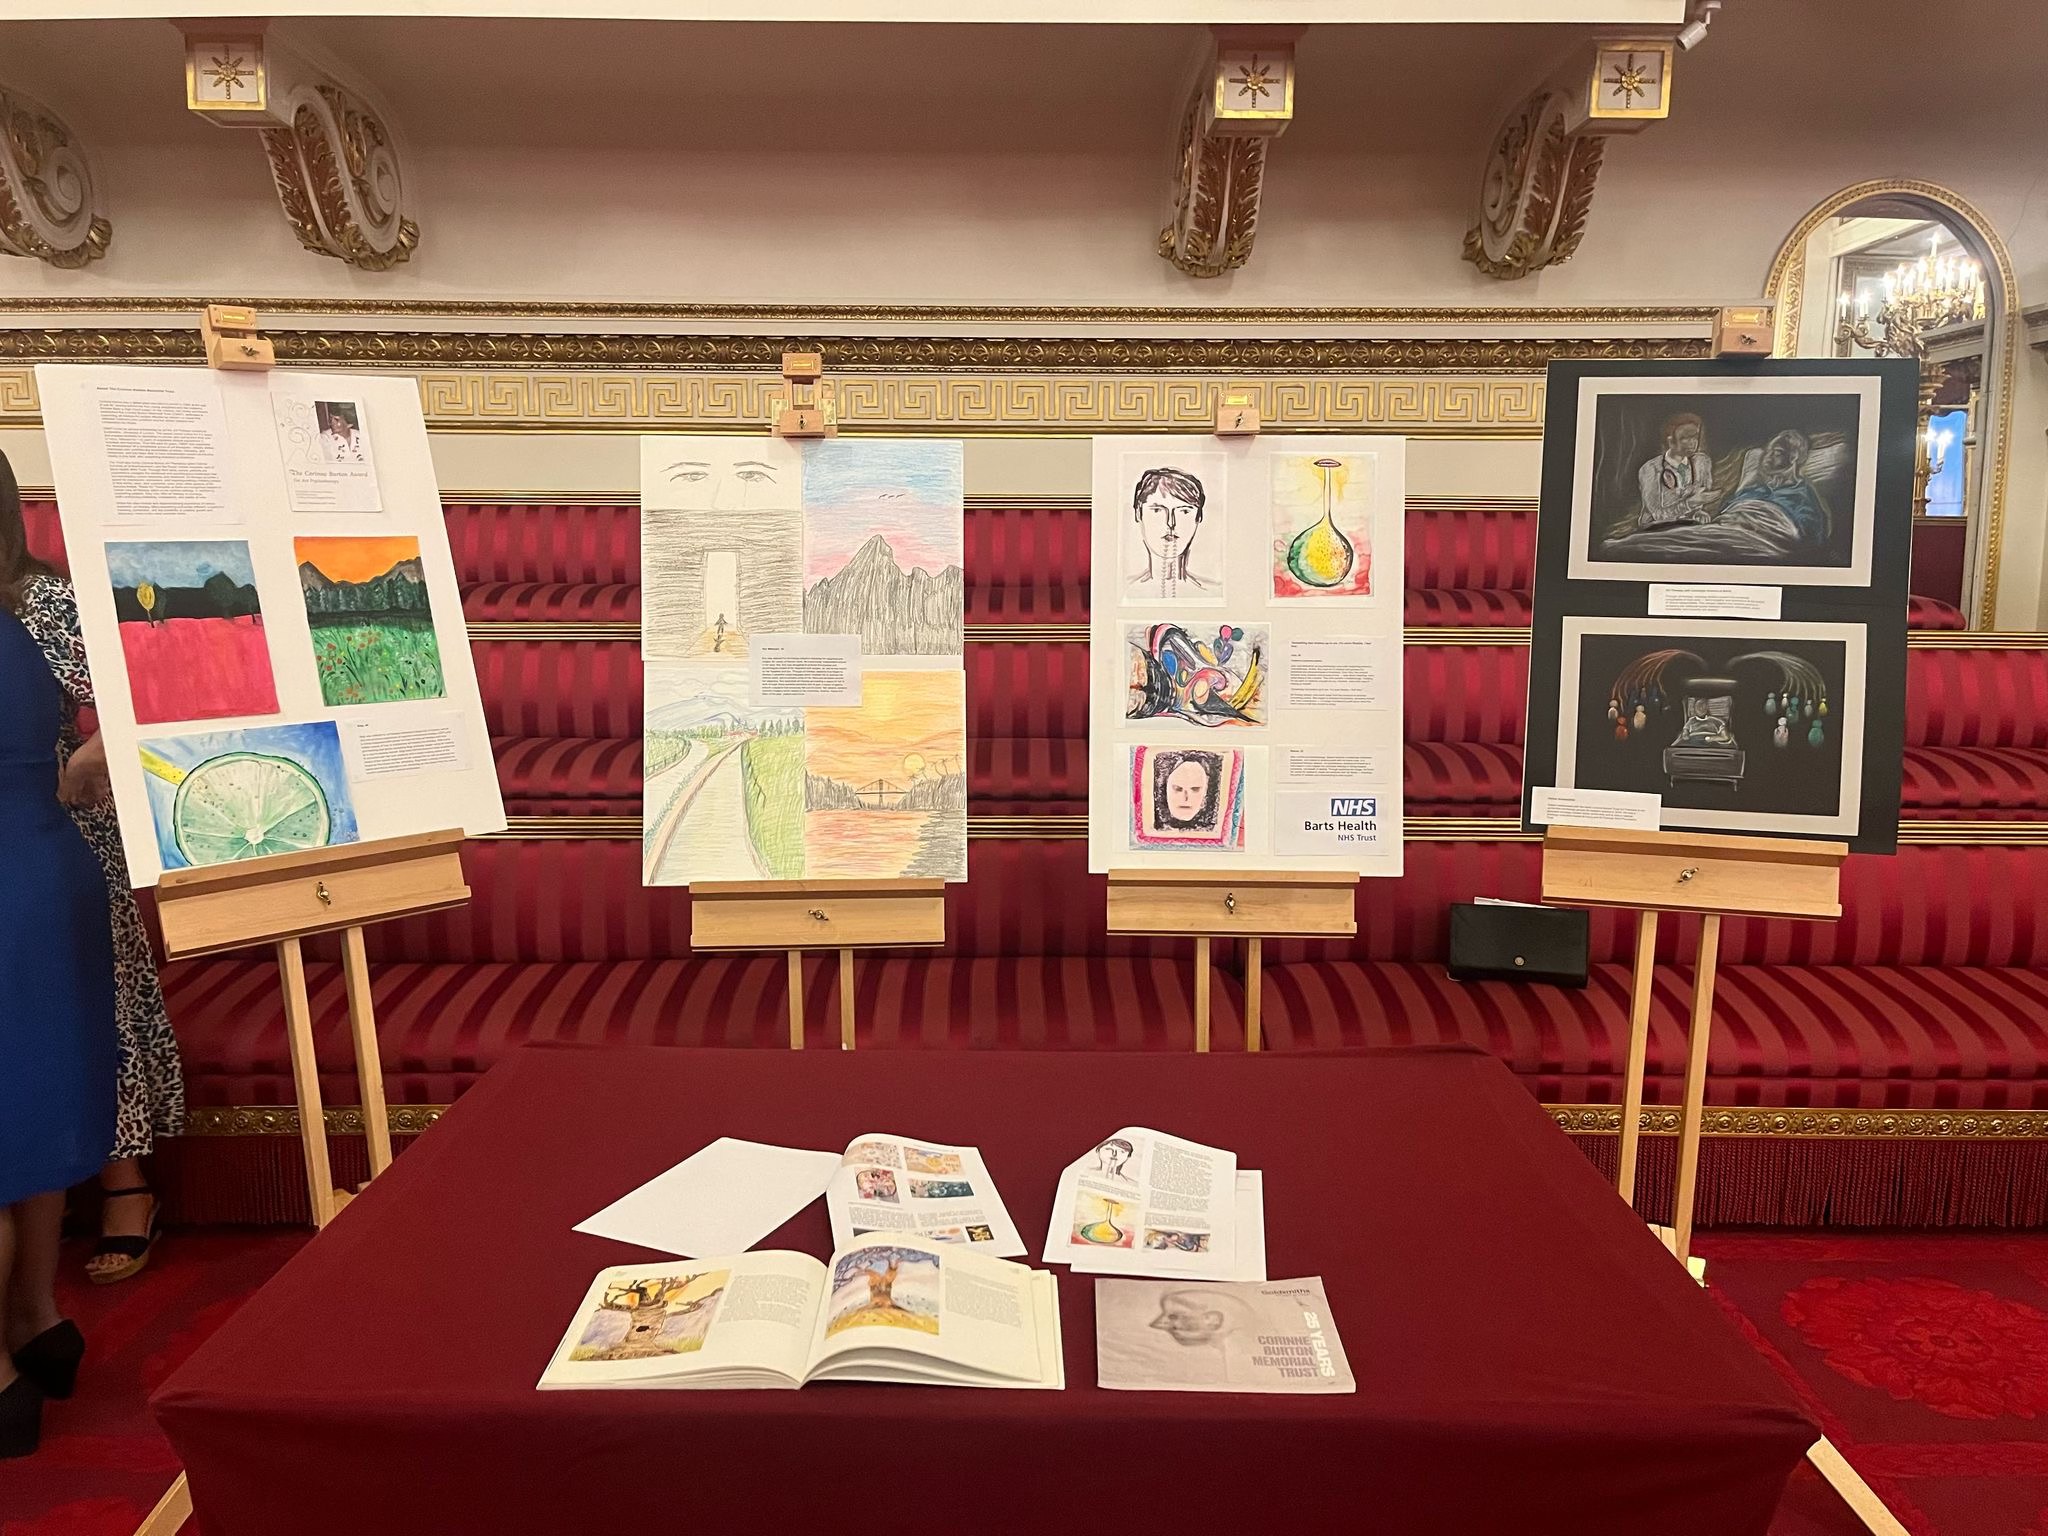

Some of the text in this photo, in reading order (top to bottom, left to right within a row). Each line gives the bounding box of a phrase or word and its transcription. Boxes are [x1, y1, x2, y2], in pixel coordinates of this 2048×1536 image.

[1331, 799, 1375, 816] NHS
[1304, 820, 1377, 831] Barts Health
[1258, 1335, 1312, 1346] CORINNE
[1303, 1311, 1336, 1377] 25 YEARS
[1263, 1346, 1314, 1356] BURTON
[1252, 1356, 1317, 1366] MEMORIAL
[1278, 1367, 1319, 1378] TRUST
